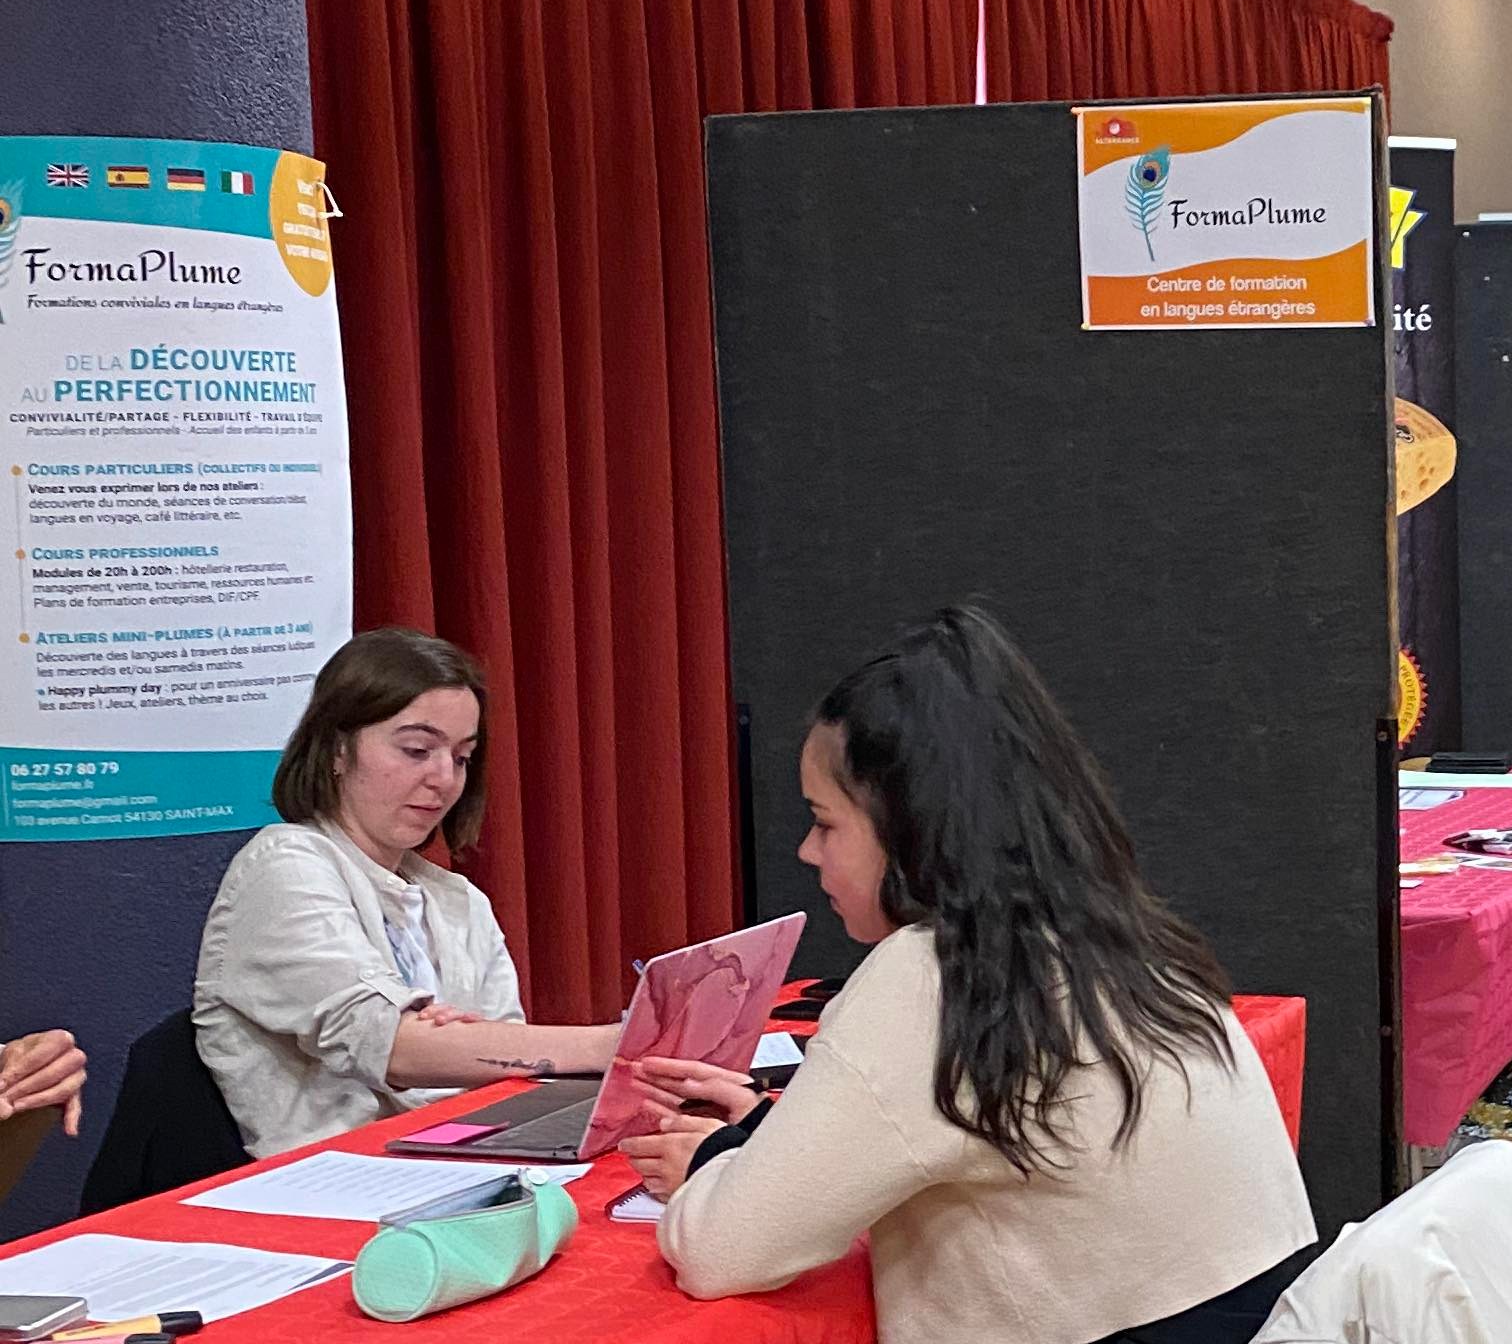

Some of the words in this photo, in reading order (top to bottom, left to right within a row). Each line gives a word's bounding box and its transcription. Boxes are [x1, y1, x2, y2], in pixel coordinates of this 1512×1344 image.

[1168, 197, 1328, 229] FormaPlume
[21, 248, 242, 286] FormaPlume
[1147, 276, 1201, 292] Centre
[1206, 276, 1226, 292] de
[1230, 275, 1307, 291] formation
[27, 293, 98, 309] Formations
[100, 295, 171, 309] conviviales
[174, 300, 189, 309] en
[192, 296, 235, 313] langues
[1140, 305, 1160, 318] en
[1163, 302, 1225, 321] langues
[1228, 301, 1316, 320] étrangères
[65, 354, 93, 371] DE
[98, 354, 124, 371] LA
[130, 343, 297, 373] DÉCOUVERTE
[20, 386, 48, 403] AU
[54, 379, 317, 404] PERFECTIONNEMENT
[182, 410, 252, 423] FLEXIBILITÉ
[26, 426, 86, 437] Particuliers
[89, 426, 100, 436] et
[102, 425, 181, 438] professionnels
[84, 462, 194, 476] PARTICULIERS
[28, 483, 66, 494] Venez
[68, 485, 97, 494] vous
[100, 482, 155, 496] exprimer
[157, 481, 180, 493] lors
[182, 480, 197, 492] de
[200, 483, 220, 492] nos
[28, 498, 96, 510] découverte
[98, 497, 114, 508] du
[213, 495, 227, 507] de
[29, 513, 77, 526] langues
[79, 514, 95, 524] en
[144, 510, 172, 523] café
[89, 545, 220, 560] PROFESSIONNELS
[32, 567, 84, 579] Modules
[87, 567, 102, 578] de
[104, 566, 129, 577] 20h
[130, 565, 139, 577] à
[141, 564, 173, 577] 200h
[33, 596, 68, 608] Plans
[69, 596, 85, 608] de
[87, 594, 147, 607] formation
[36, 651, 104, 663] Découverte
[106, 650, 129, 662] des
[131, 648, 179, 662] langues
[47, 685, 86, 698] Happy
[88, 683, 139, 697] plummy
[140, 682, 162, 695] day
[171, 680, 198, 694] pour
[10, 763, 30, 777] 06
[32, 763, 51, 777] 27
[53, 762, 73, 776] 57
[100, 761, 120, 775] 79
